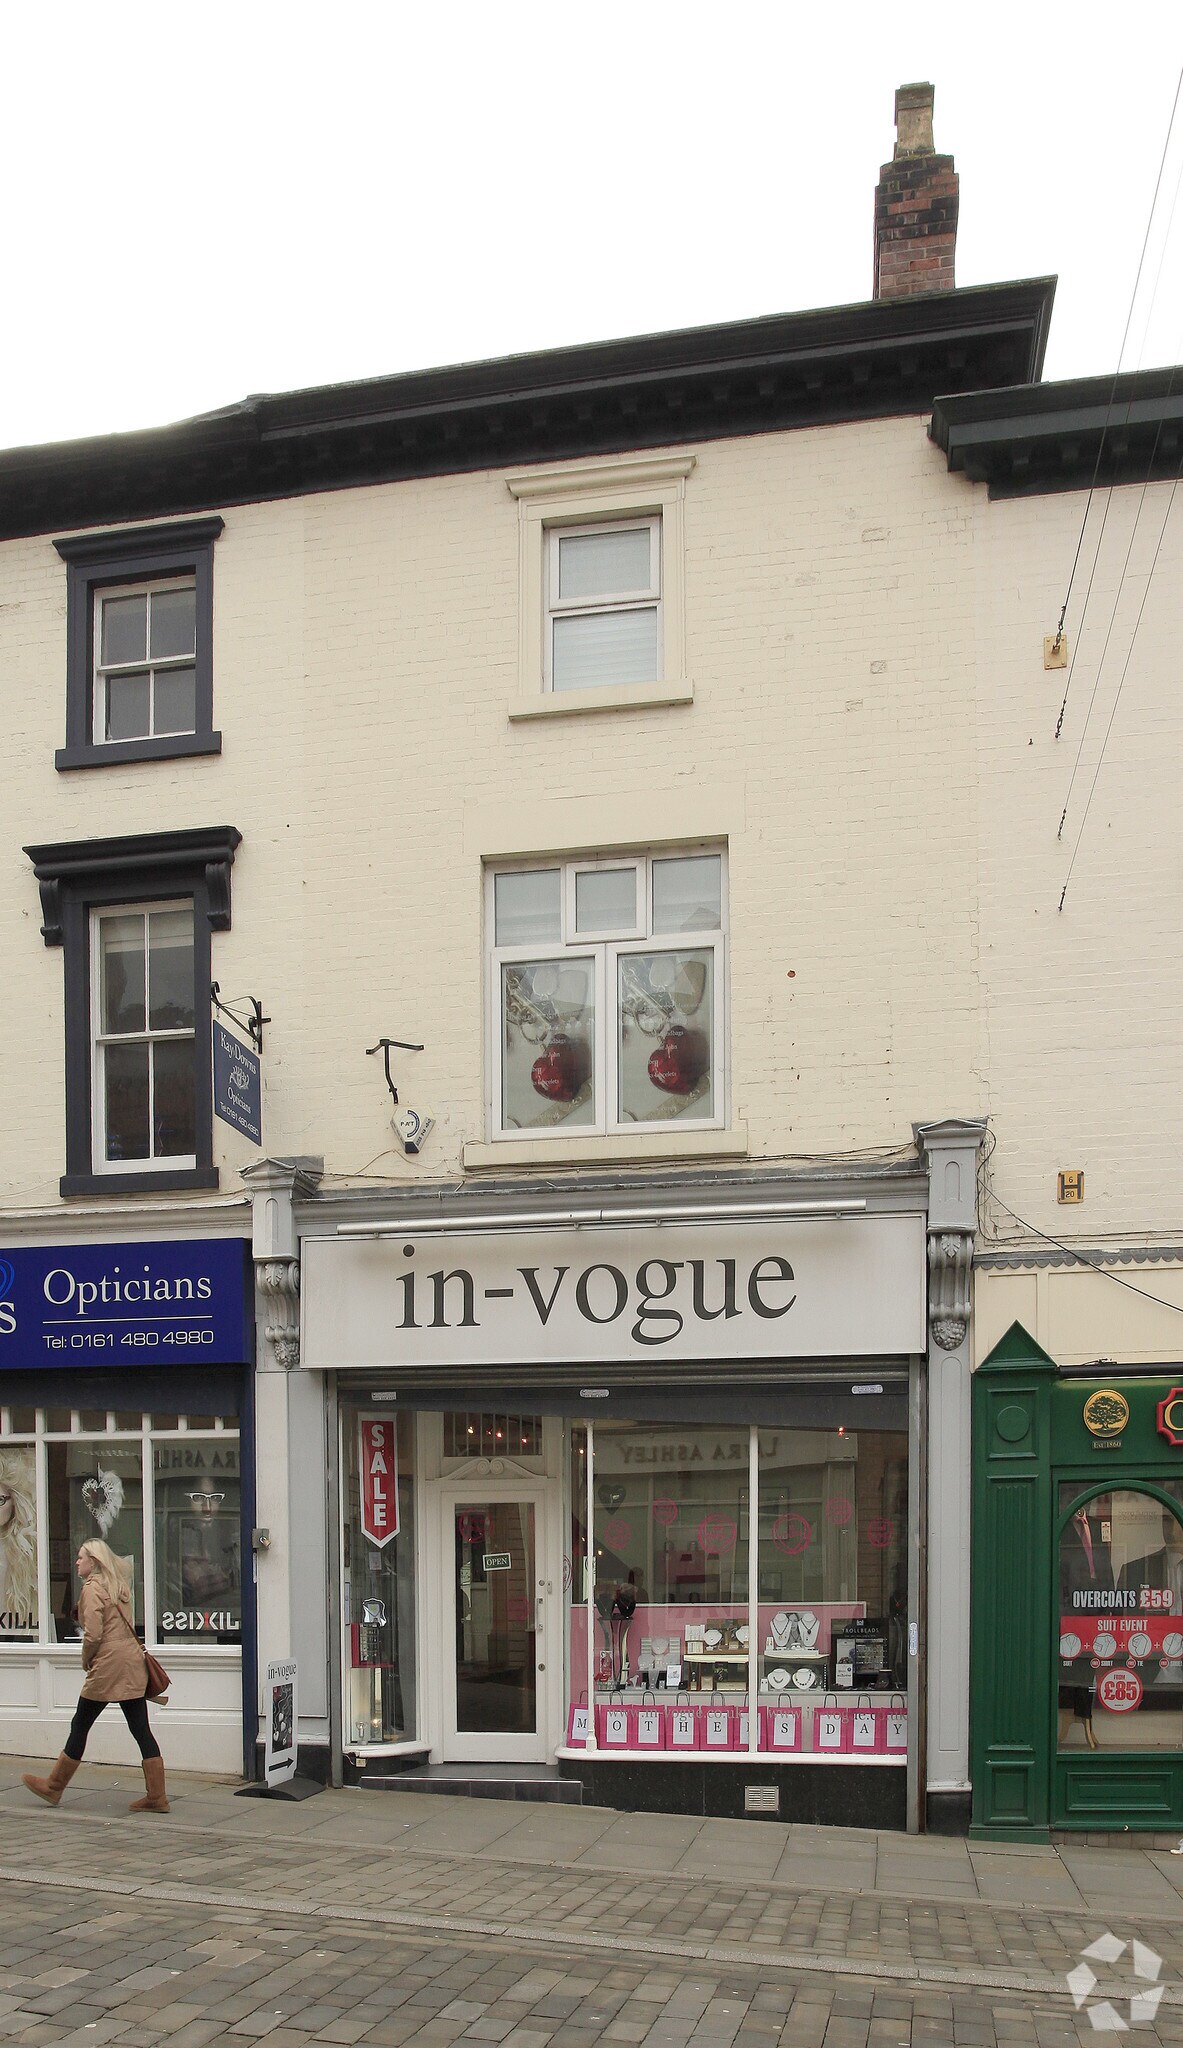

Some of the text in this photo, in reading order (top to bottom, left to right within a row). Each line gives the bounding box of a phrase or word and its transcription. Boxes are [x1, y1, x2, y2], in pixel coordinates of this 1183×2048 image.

[220, 1032, 257, 1075] Kay Downs
[1068, 1176, 1074, 1184] 6
[1065, 1190, 1075, 1198] 20
[43, 1265, 212, 1315] Opticians
[395, 1244, 797, 1345] in-vogue
[42, 1330, 214, 1349] Tel: 0161 480 4980
[370, 1424, 388, 1526] SALE
[486, 1557, 508, 1567] OPEN
[1072, 1589, 1174, 1608] OVERCOATS £59
[1097, 1619, 1149, 1631] SUIT EVENT
[268, 1663, 297, 1681] in-vogue
[1104, 1680, 1137, 1701] £85
[608, 1705, 744, 1721] www.in-vogue.co.uk
[826, 1723, 903, 1735] DAY
